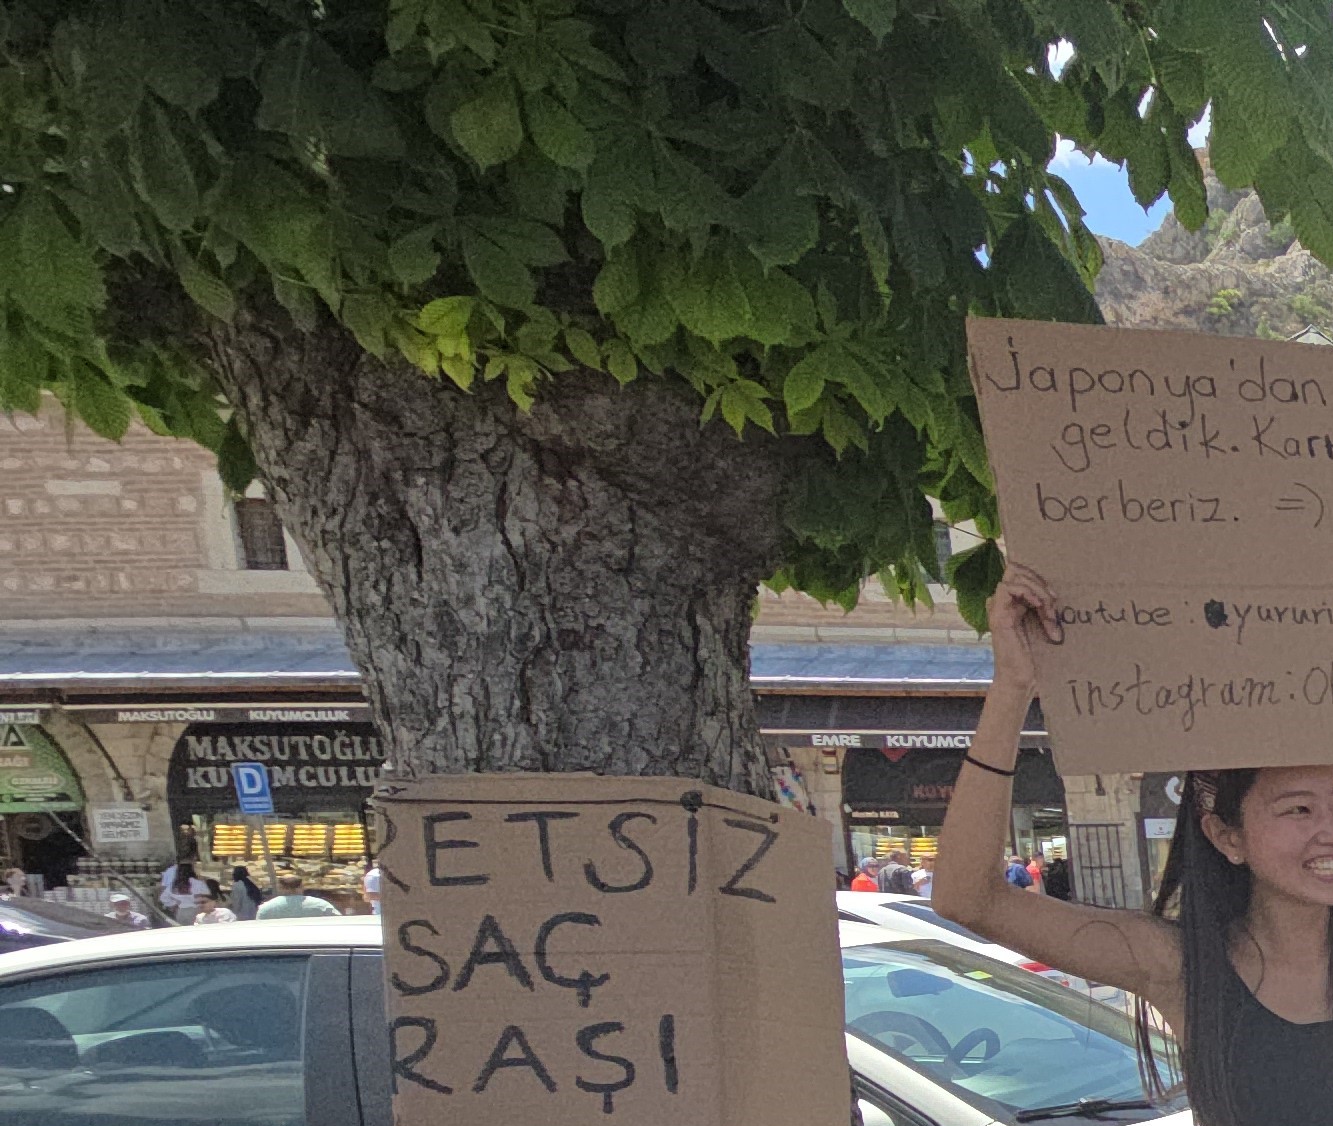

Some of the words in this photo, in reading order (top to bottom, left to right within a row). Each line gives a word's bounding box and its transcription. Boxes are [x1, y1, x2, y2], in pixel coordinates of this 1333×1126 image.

[1036, 479, 1240, 523] berberiz.
[249, 709, 349, 721] KUYUMCULUK
[186, 730, 387, 761] MAKSUTOĞLU
[811, 734, 861, 747] EMRE
[239, 767, 262, 793] D
[391, 911, 610, 1008] SAÇ
[389, 1014, 679, 1114] RAŞI
